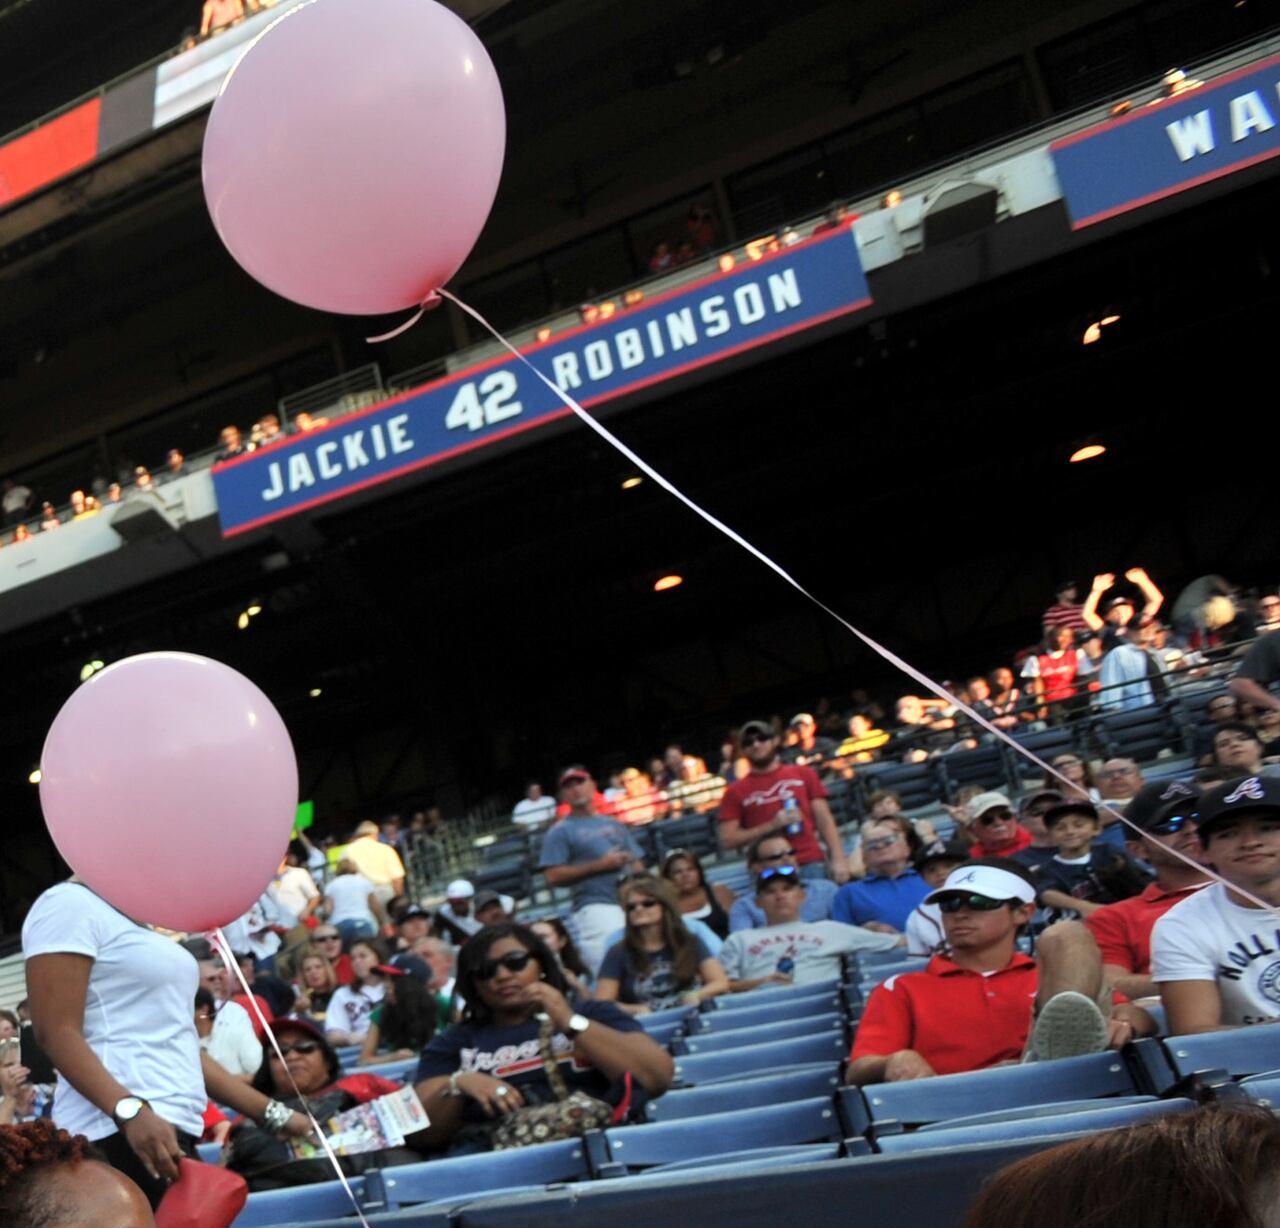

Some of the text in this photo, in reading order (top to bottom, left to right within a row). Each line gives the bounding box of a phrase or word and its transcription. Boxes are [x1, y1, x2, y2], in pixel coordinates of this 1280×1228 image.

[1165, 80, 1280, 162] WA
[262, 267, 802, 502] JACKIE 42 ROBINSON
